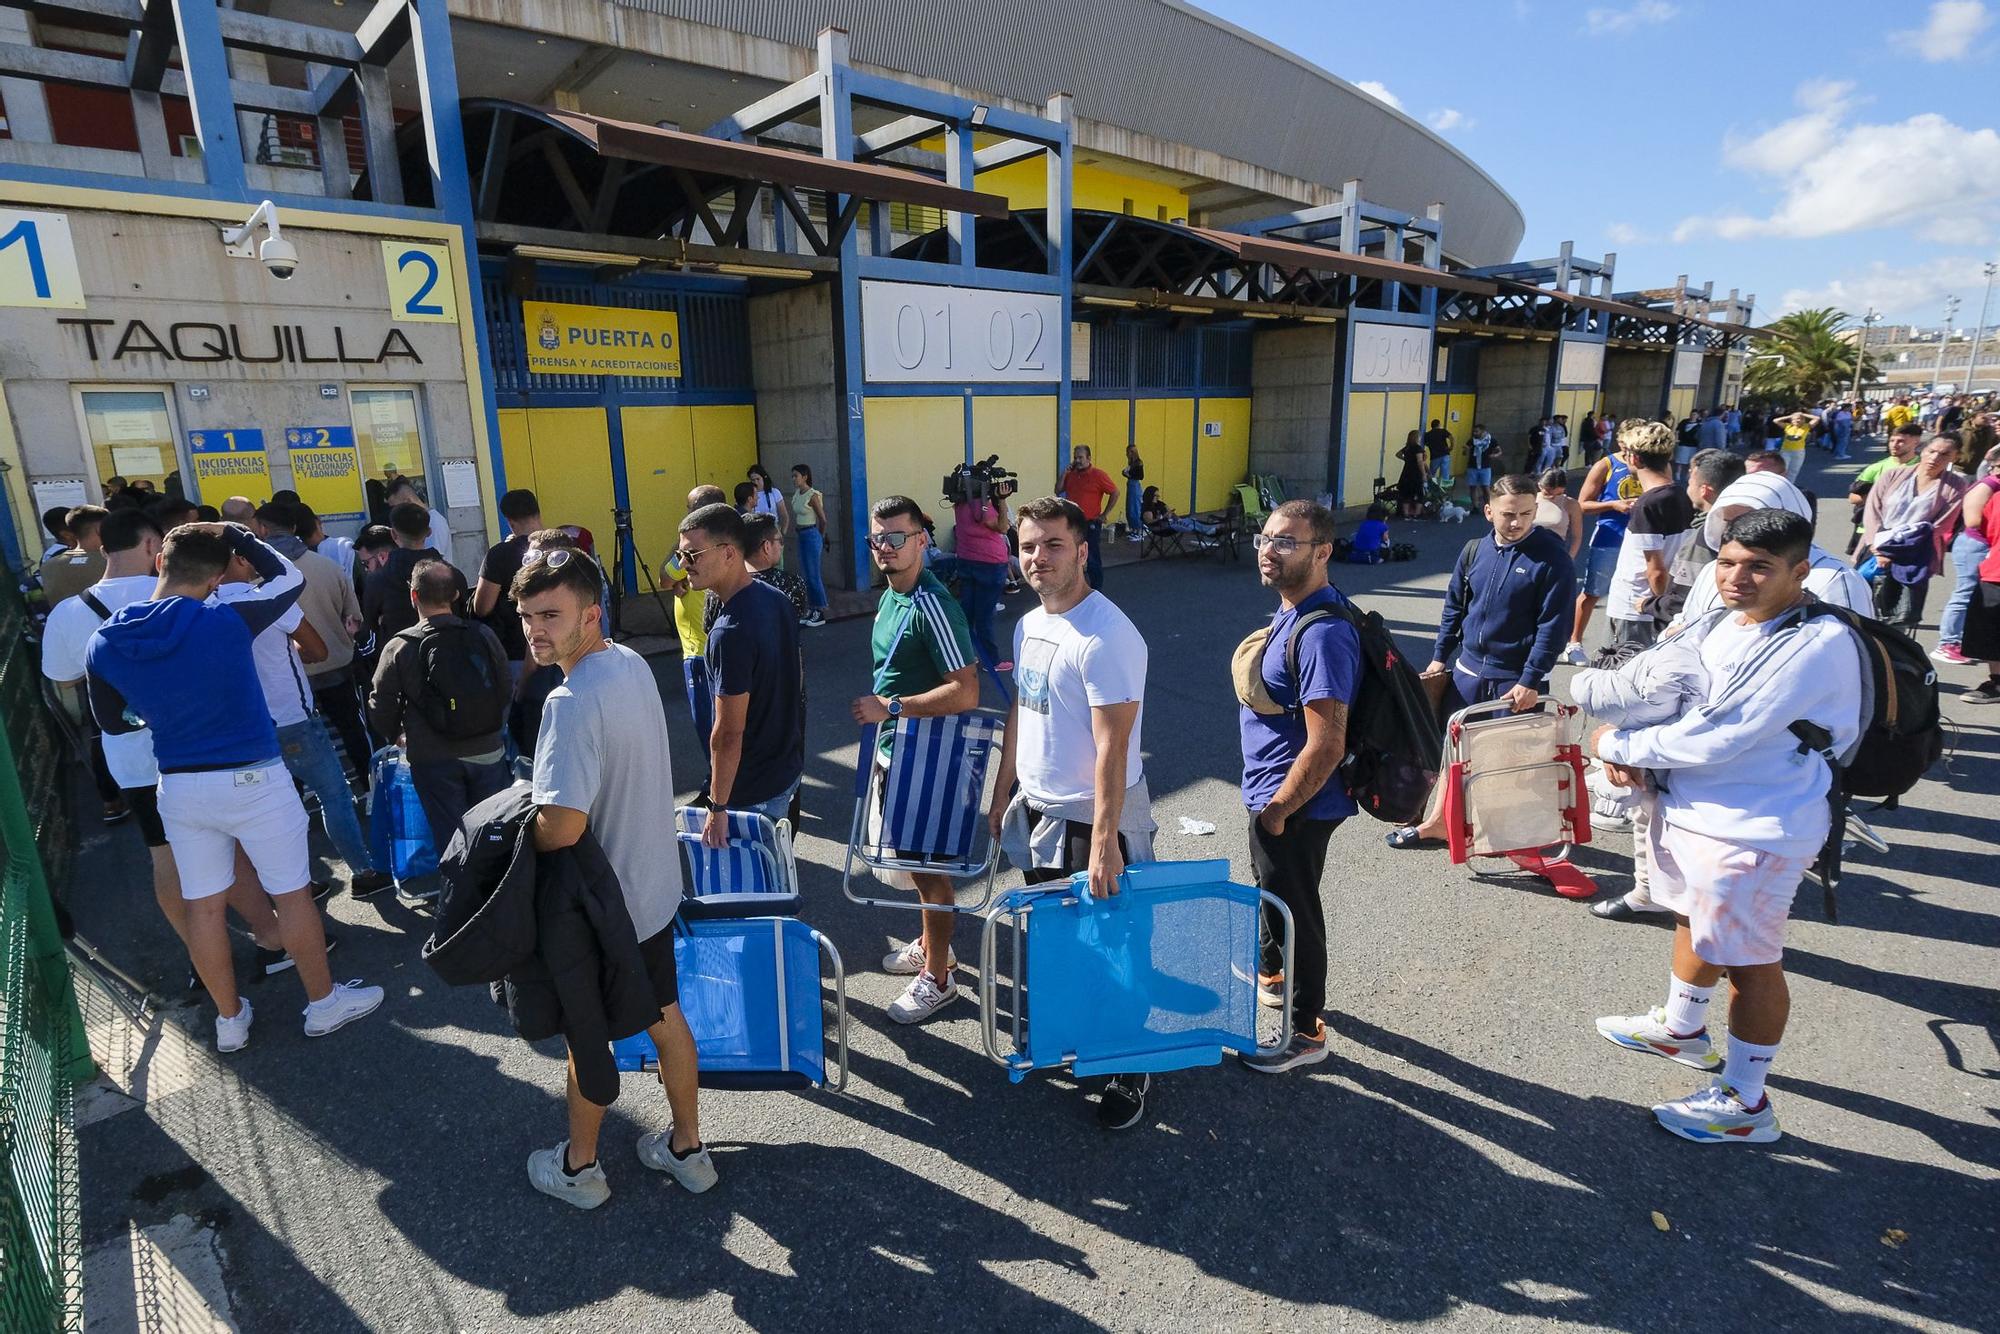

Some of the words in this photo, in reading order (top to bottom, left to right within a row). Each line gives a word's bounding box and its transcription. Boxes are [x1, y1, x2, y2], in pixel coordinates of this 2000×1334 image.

[0, 220, 52, 298] 1
[397, 250, 444, 315] 2
[57, 318, 423, 364] TAQUILLA
[567, 327, 655, 349] PUERTA
[660, 332, 673, 350] 0
[893, 303, 952, 370] 01
[985, 304, 1045, 371] 02
[532, 356, 577, 368] PRENSA
[580, 358, 588, 368] Y
[590, 359, 680, 372] ACREDITACIONES
[191, 388, 209, 397] 01
[321, 387, 338, 396] 02
[224, 432, 237, 451] 1
[316, 428, 332, 447] 2
[198, 457, 265, 469] INCIDENCIAS
[293, 452, 354, 464] INCIDENCIAS
[200, 467, 210, 477] DE
[211, 466, 237, 477] VENTA
[238, 465, 266, 475] ONLINE
[295, 463, 305, 473] DE
[305, 461, 355, 472] AFICIONADOS
[303, 469, 309, 479] Y
[309, 468, 350, 479] ABONADOS
[1679, 992, 1710, 1005] FILA
